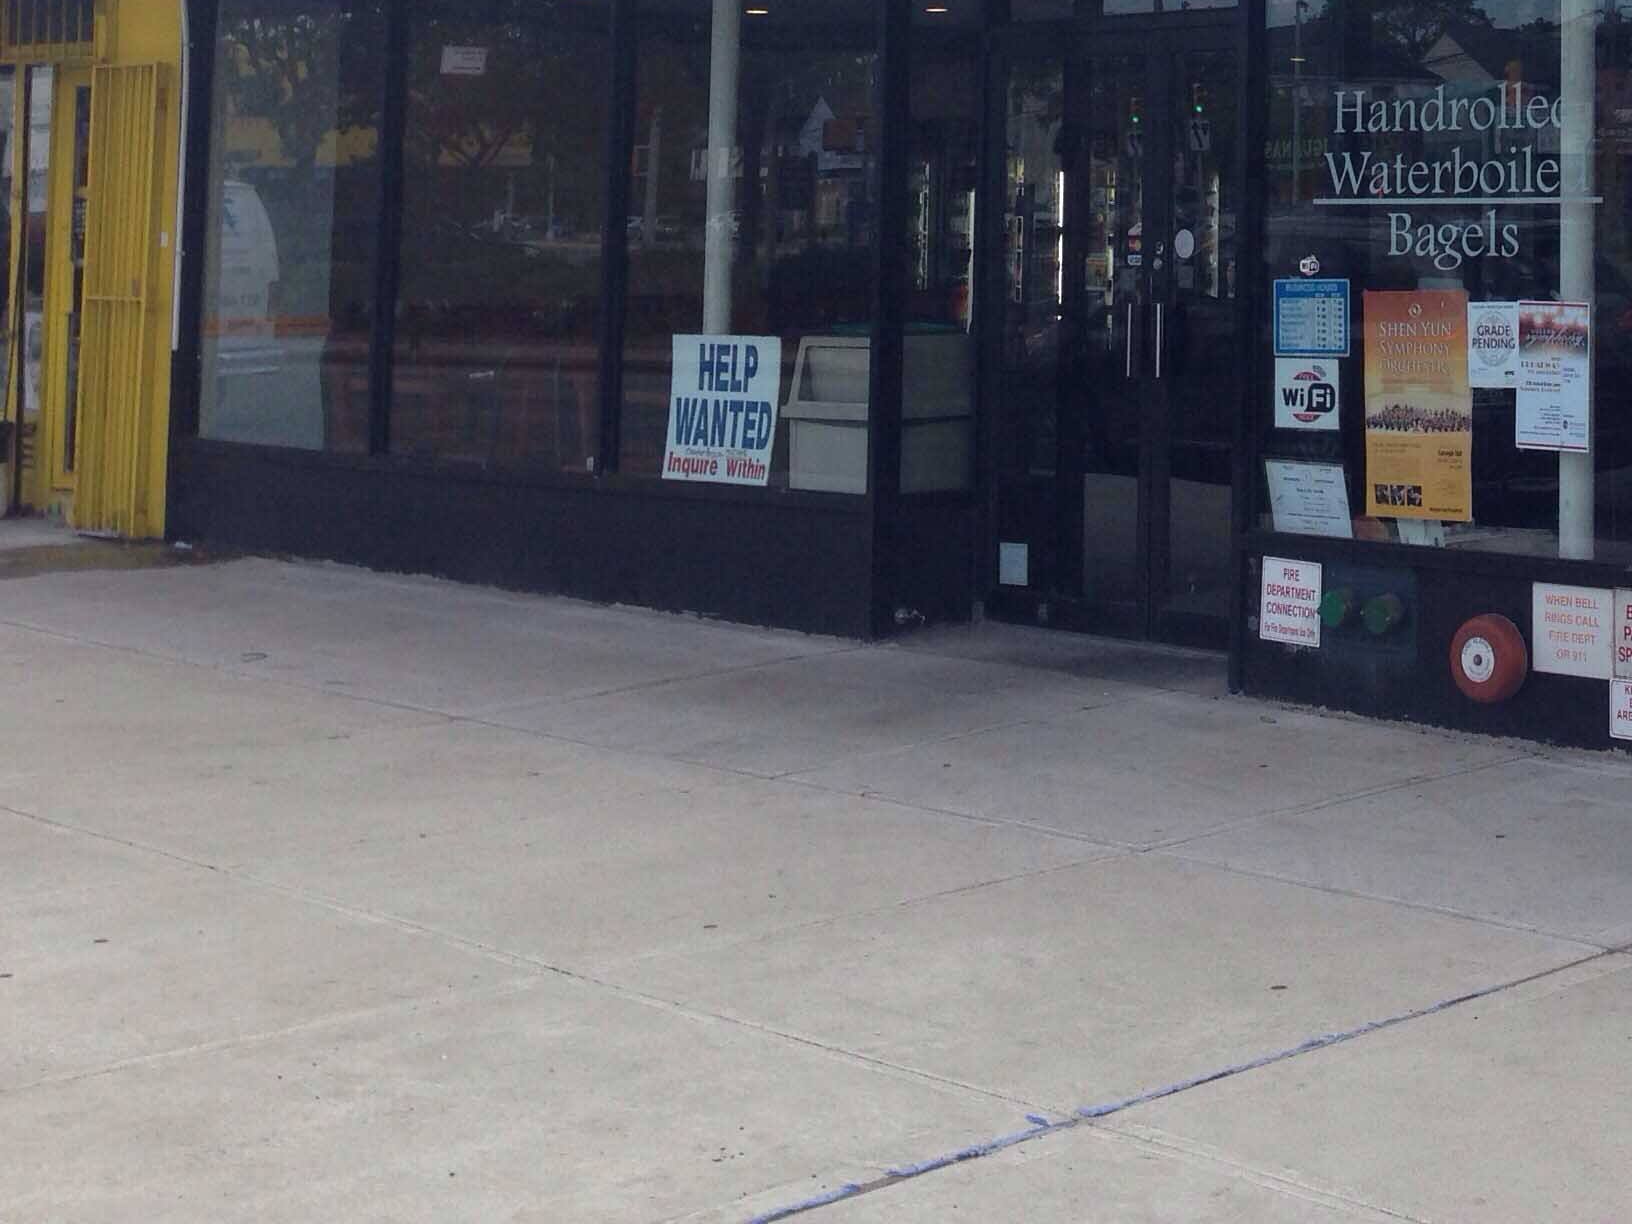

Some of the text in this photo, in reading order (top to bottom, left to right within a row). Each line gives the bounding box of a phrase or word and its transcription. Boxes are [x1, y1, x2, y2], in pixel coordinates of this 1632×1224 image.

[1387, 209, 1520, 270] Bagels
[1378, 320, 1452, 337] SHEN YUN
[1476, 325, 1511, 337] GRADE
[1378, 340, 1451, 357] SYMPHONY
[1471, 338, 1516, 350] PENDING
[698, 343, 759, 393] HELP
[675, 397, 773, 451] WANTED
[1283, 568, 1300, 582] FIRE
[1266, 584, 1316, 601] DEPARTMENT
[1266, 602, 1316, 619] CONNECTION
[1545, 594, 1600, 610] WHEN BELL
[1544, 611, 1600, 627] RINGS CALL
